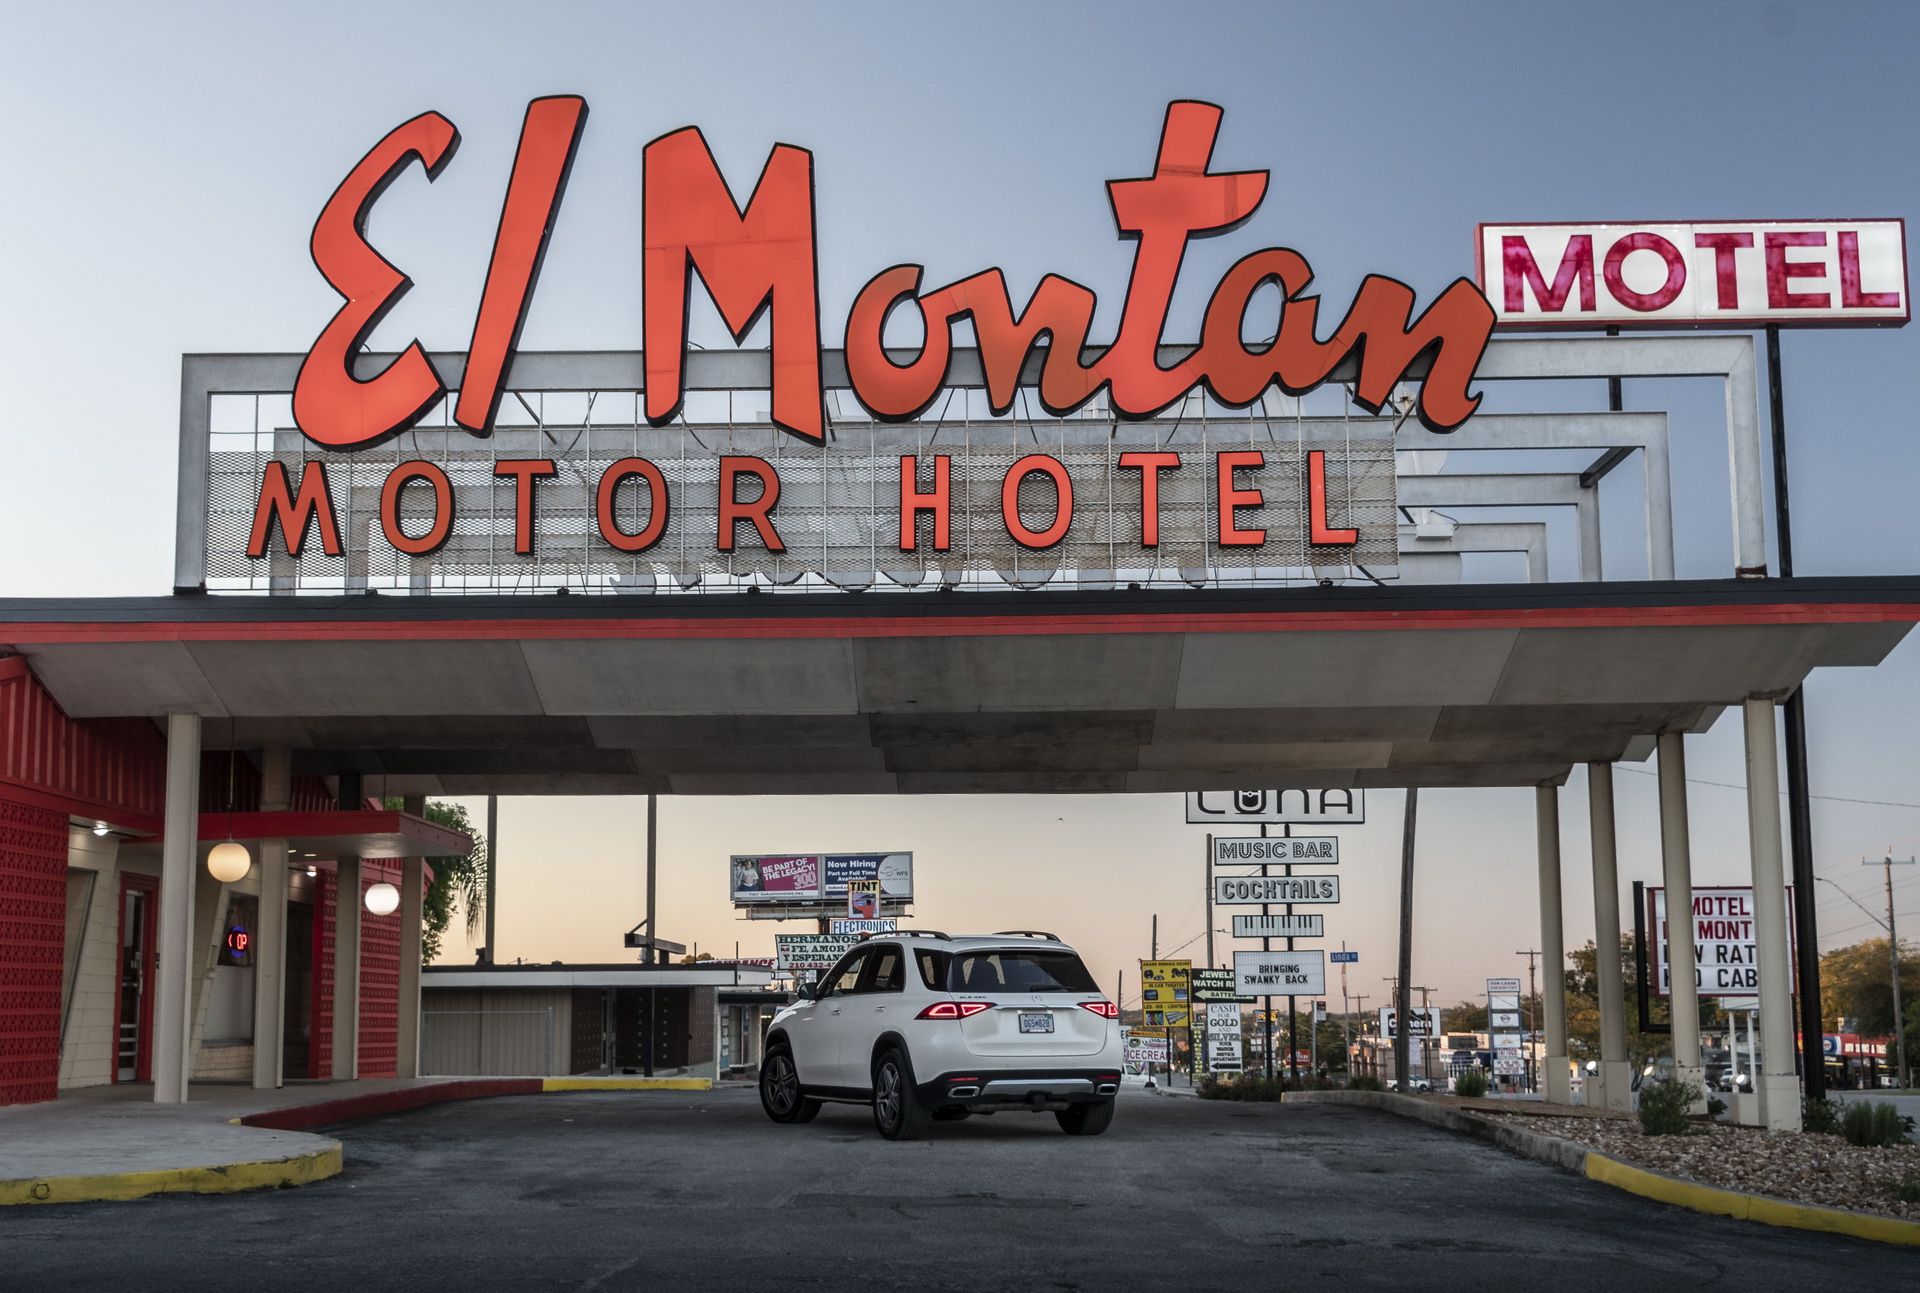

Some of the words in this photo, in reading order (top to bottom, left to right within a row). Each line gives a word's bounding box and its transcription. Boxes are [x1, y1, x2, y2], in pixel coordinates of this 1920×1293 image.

[292, 94, 589, 452] El
[642, 99, 1497, 447] Montan
[1501, 231, 1900, 312] MOTEL
[246, 455, 787, 558] MOTOR
[899, 450, 1359, 552] HOTEL
[1219, 842, 1287, 859] MUSIC
[1293, 841, 1333, 858] BAR
[762, 866, 773, 874] BE
[774, 860, 795, 871] PART
[796, 857, 808, 867] OF
[850, 860, 876, 868] Hiring
[763, 871, 780, 881] THE
[781, 863, 816, 877] LEGACY!
[793, 871, 817, 887] 300
[850, 882, 878, 891] TINT
[1222, 879, 1333, 899] COCKTAILS
[833, 920, 895, 934] ELECTRONICS
[1698, 921, 1752, 940] MONT
[791, 945, 809, 953] FE,
[1716, 944, 1756, 963] RAT
[1331, 952, 1350, 961] Linda
[1200, 971, 1234, 979] JEWELR
[1259, 965, 1299, 973] BRINGING
[1193, 980, 1224, 988] WATCH
[1244, 975, 1280, 984] SWANKY
[1285, 975, 1308, 984] BACK
[1717, 969, 1758, 987] CAB
[1211, 1004, 1236, 1013] CASH
[1210, 1019, 1238, 1027] GOLD
[1209, 1033, 1241, 1041] SILVER
